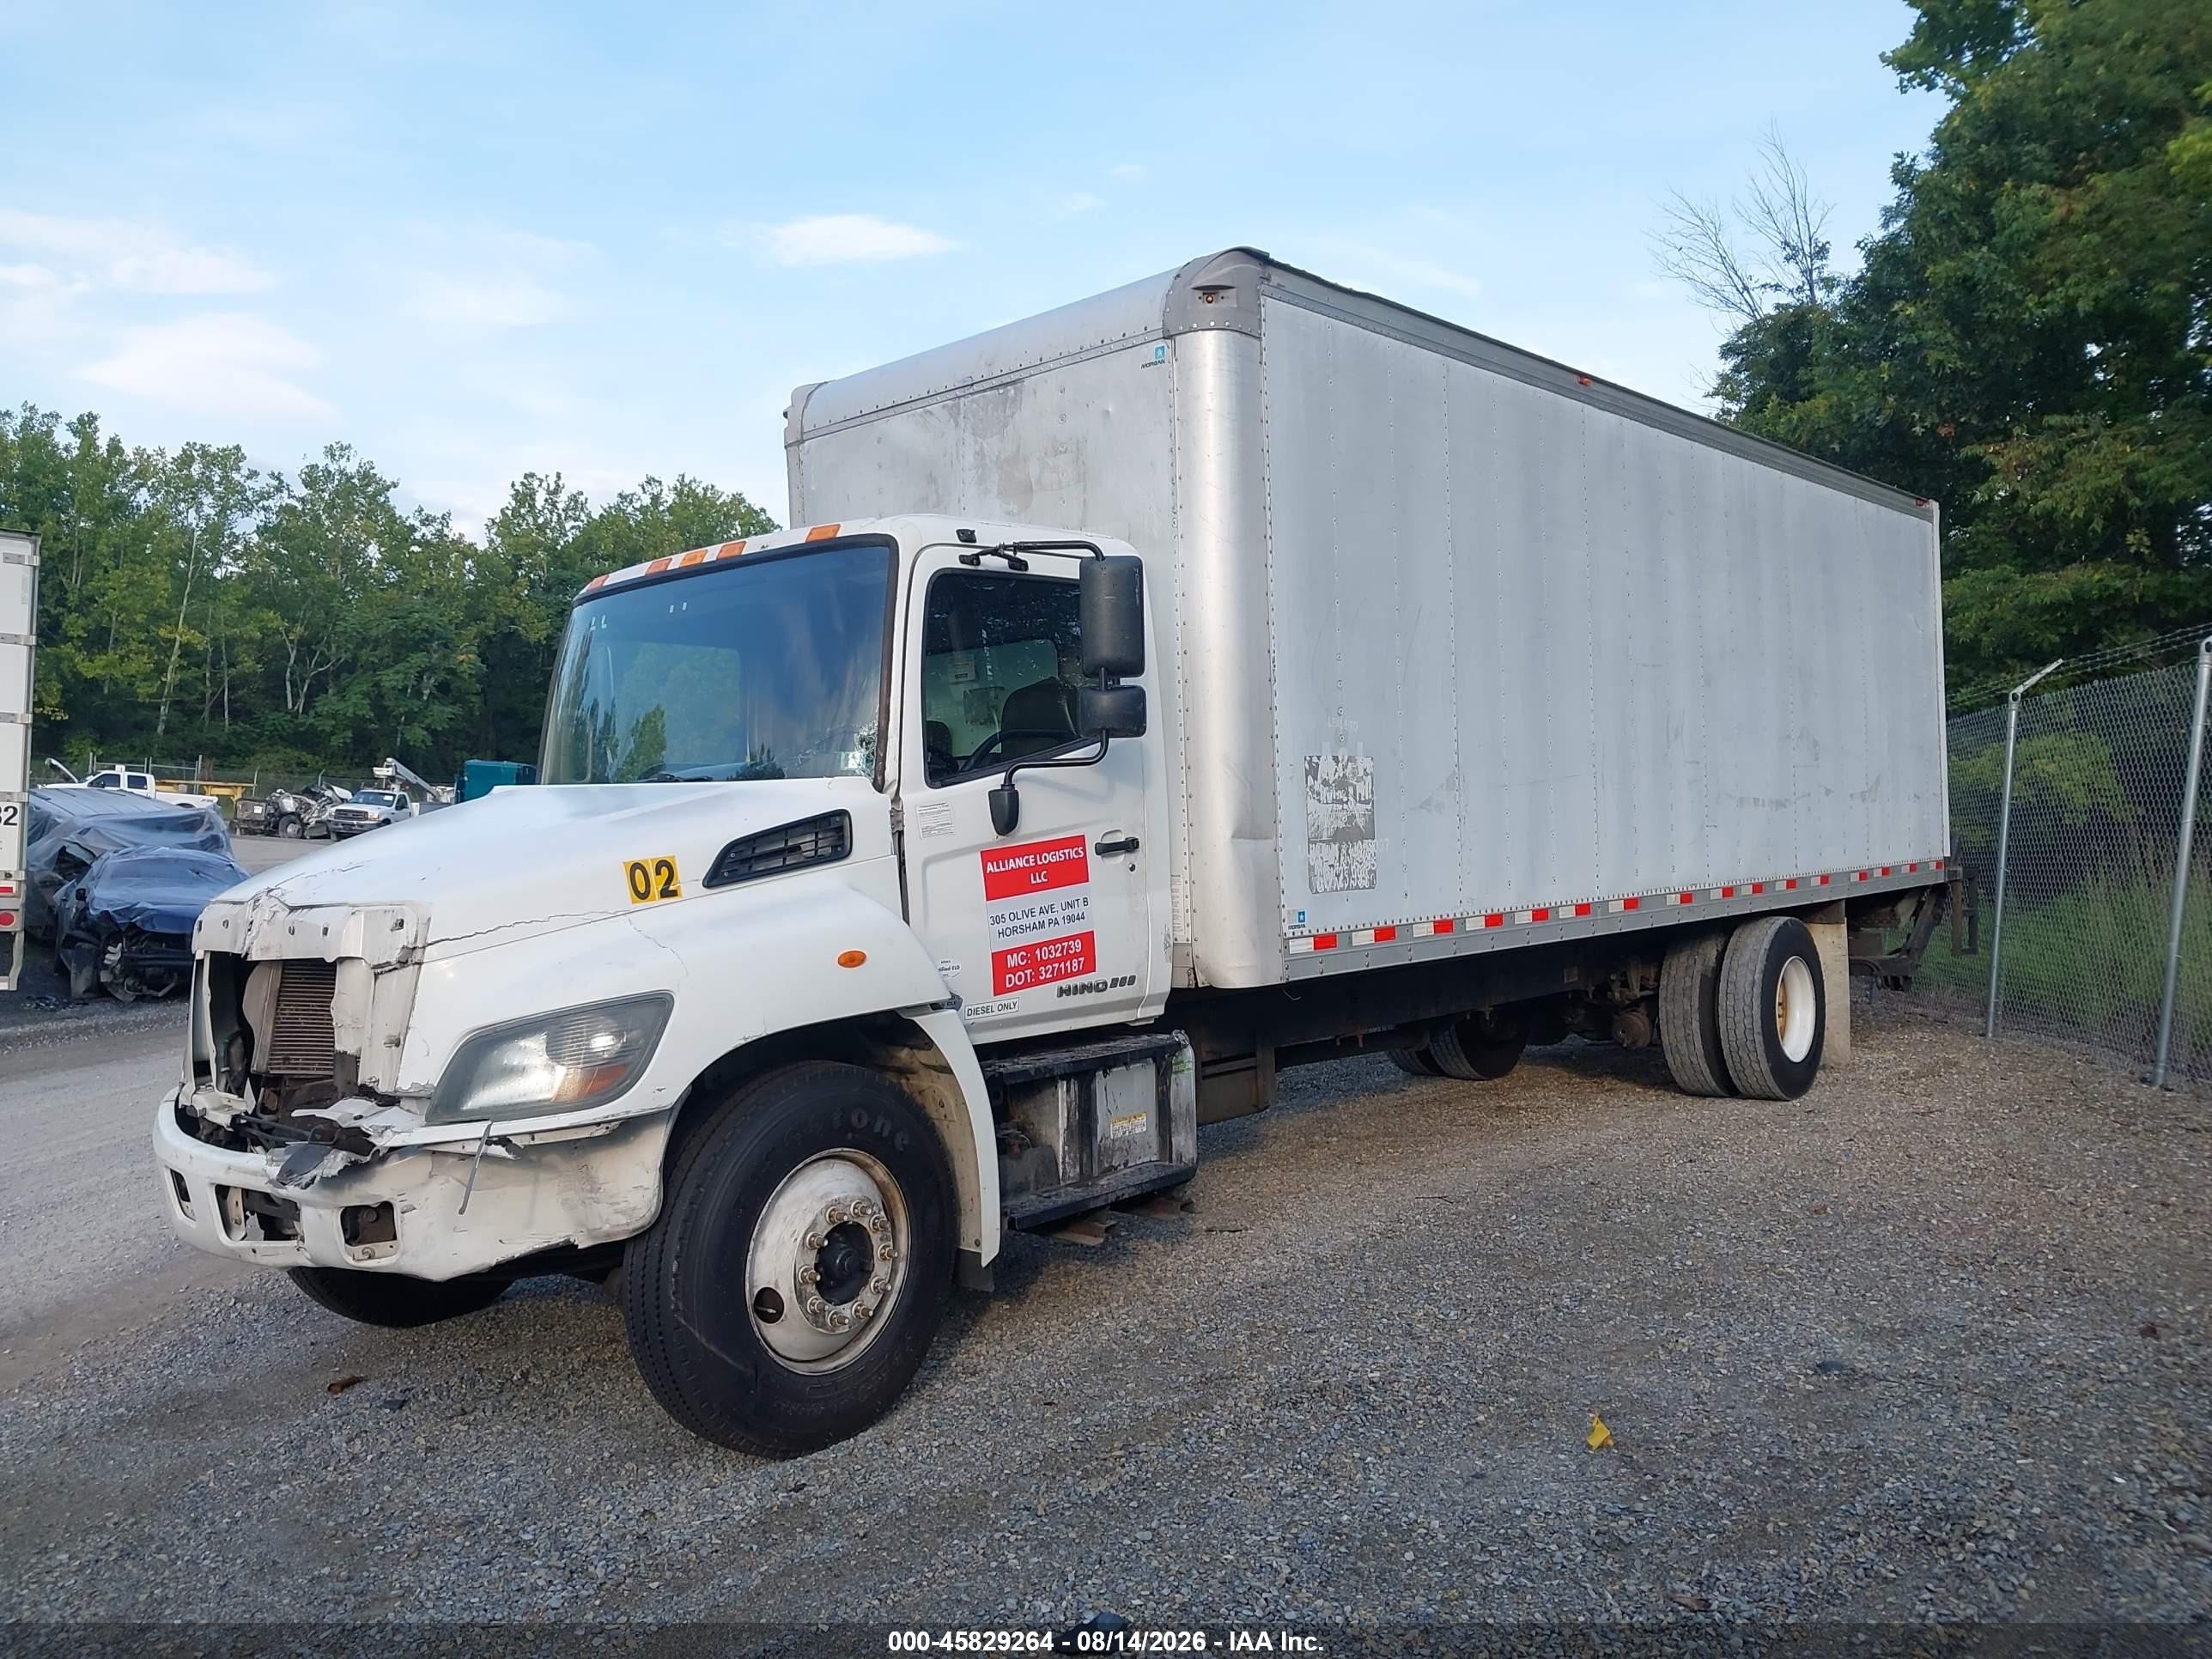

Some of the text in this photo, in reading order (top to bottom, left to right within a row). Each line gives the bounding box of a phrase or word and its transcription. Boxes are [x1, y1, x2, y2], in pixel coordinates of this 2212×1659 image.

[0, 805, 18, 826] 2
[986, 846, 1085, 874] ALLIANCE LOGISTICS
[629, 860, 678, 901] 02
[1030, 870, 1048, 884] LLC
[989, 896, 1089, 926] 305 OLIVE AVE, UNIT B
[997, 911, 1085, 939] HORSHAM PA 19044
[1006, 939, 1082, 969] MC: 1032739
[1005, 957, 1085, 988] DOT: 3271187
[1056, 979, 1109, 998] HINO
[966, 1001, 1018, 1017] DIESEL ONLY
